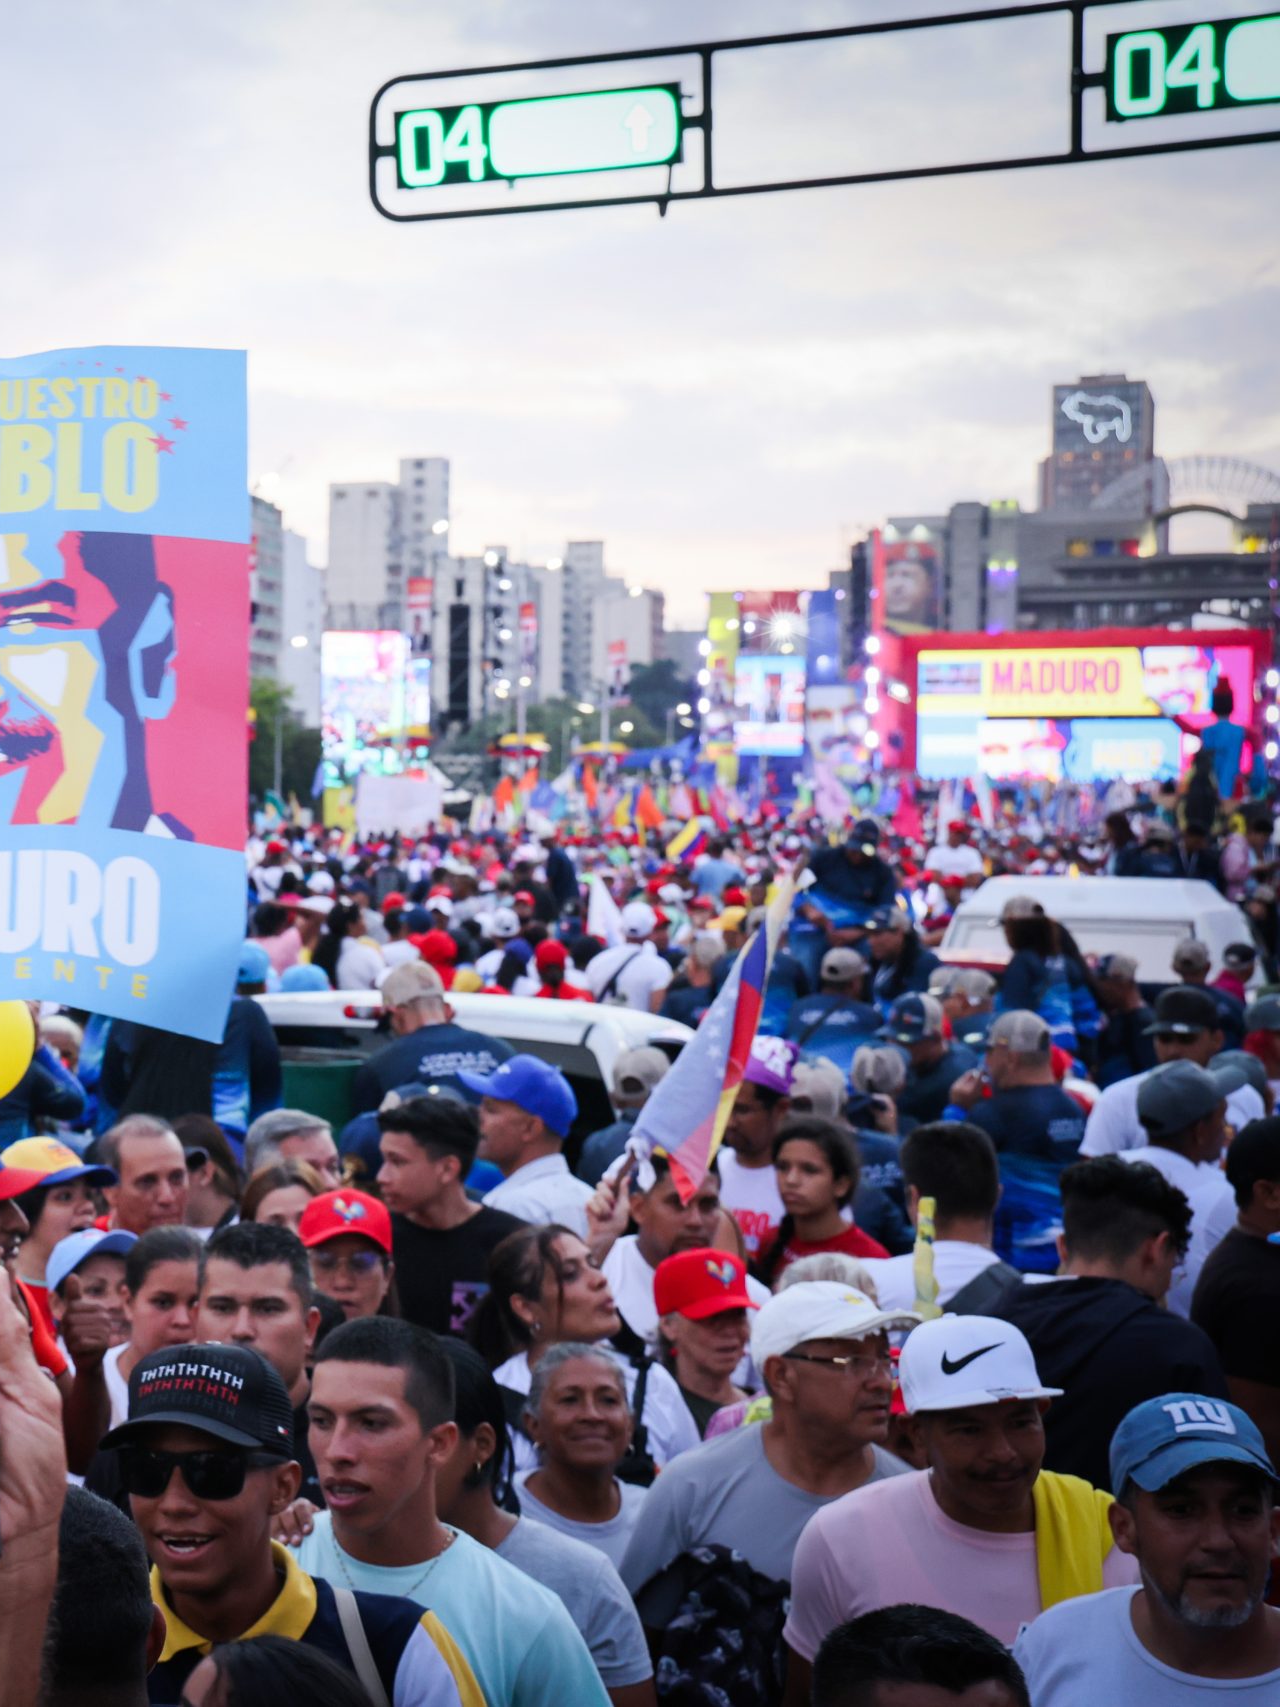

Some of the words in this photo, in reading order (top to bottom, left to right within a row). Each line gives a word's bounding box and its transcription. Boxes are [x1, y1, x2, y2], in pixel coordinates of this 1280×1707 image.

[1113, 23, 1221, 117] 04
[398, 104, 488, 188] 04
[991, 658, 1122, 695] MADURO
